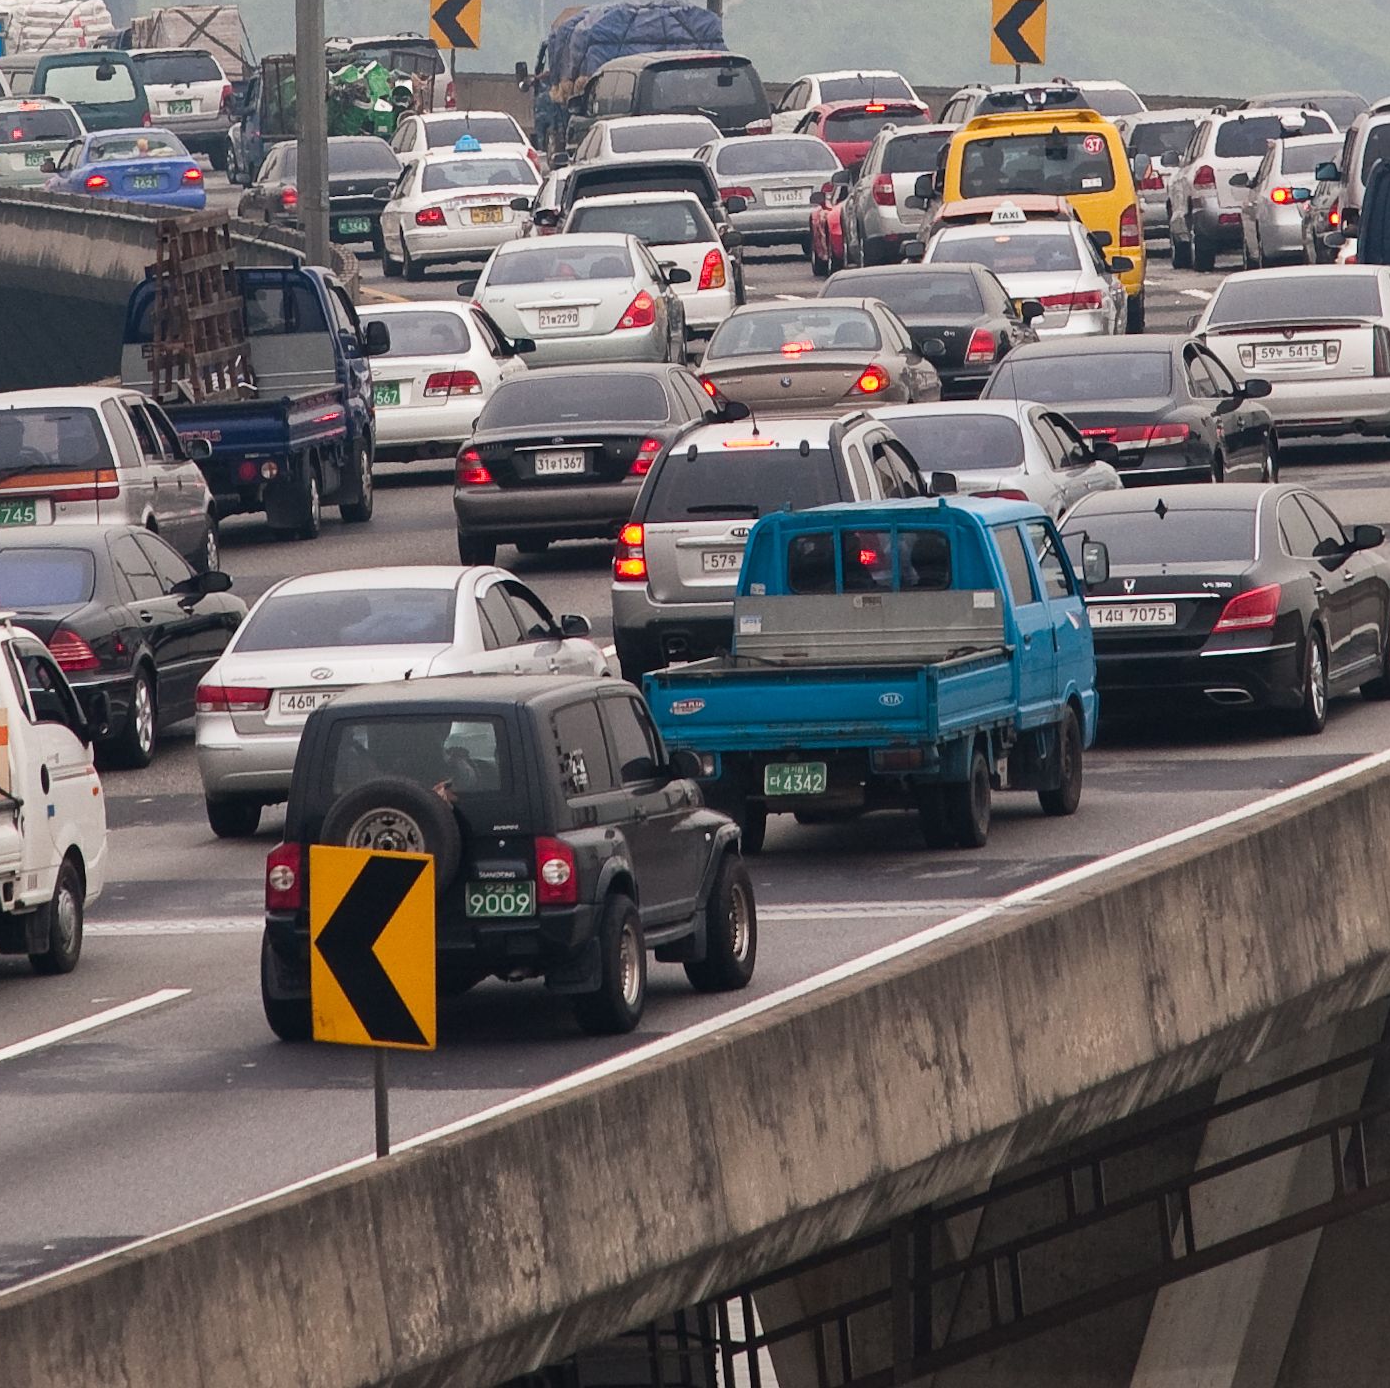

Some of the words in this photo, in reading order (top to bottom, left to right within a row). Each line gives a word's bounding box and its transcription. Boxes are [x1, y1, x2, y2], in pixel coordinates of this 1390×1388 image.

[1086, 137, 1102, 150] 37
[998, 212, 1020, 220] TAXI
[1289, 346, 1319, 358] 5415
[1130, 608, 1167, 622] 7075
[784, 774, 822, 792] 4342
[469, 893, 529, 914] 9009
